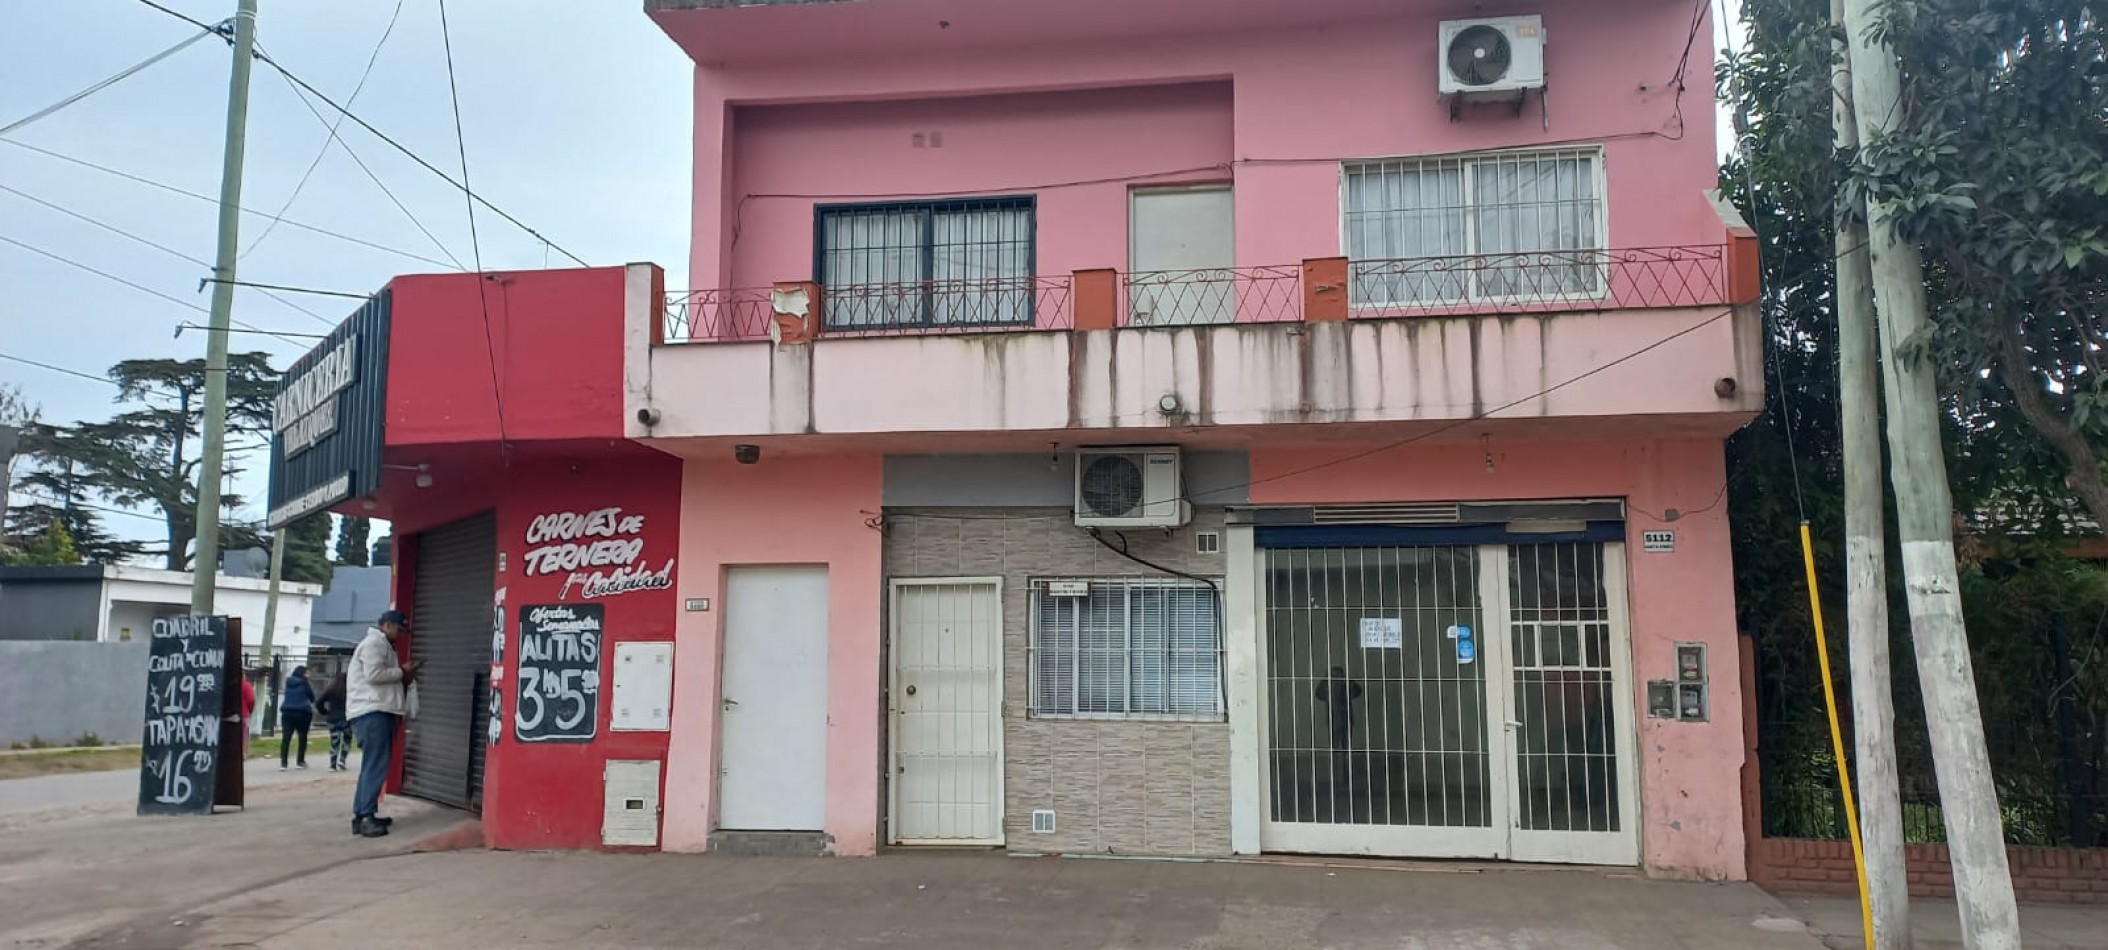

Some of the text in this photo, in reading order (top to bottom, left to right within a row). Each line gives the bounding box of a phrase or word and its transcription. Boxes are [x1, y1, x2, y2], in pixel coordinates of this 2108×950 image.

[526, 507, 622, 543] CARNES
[1645, 533, 1672, 542] 5112
[524, 538, 644, 576] TERNERA
[153, 617, 215, 639] CUADRIL
[521, 632, 596, 663] ALITAS
